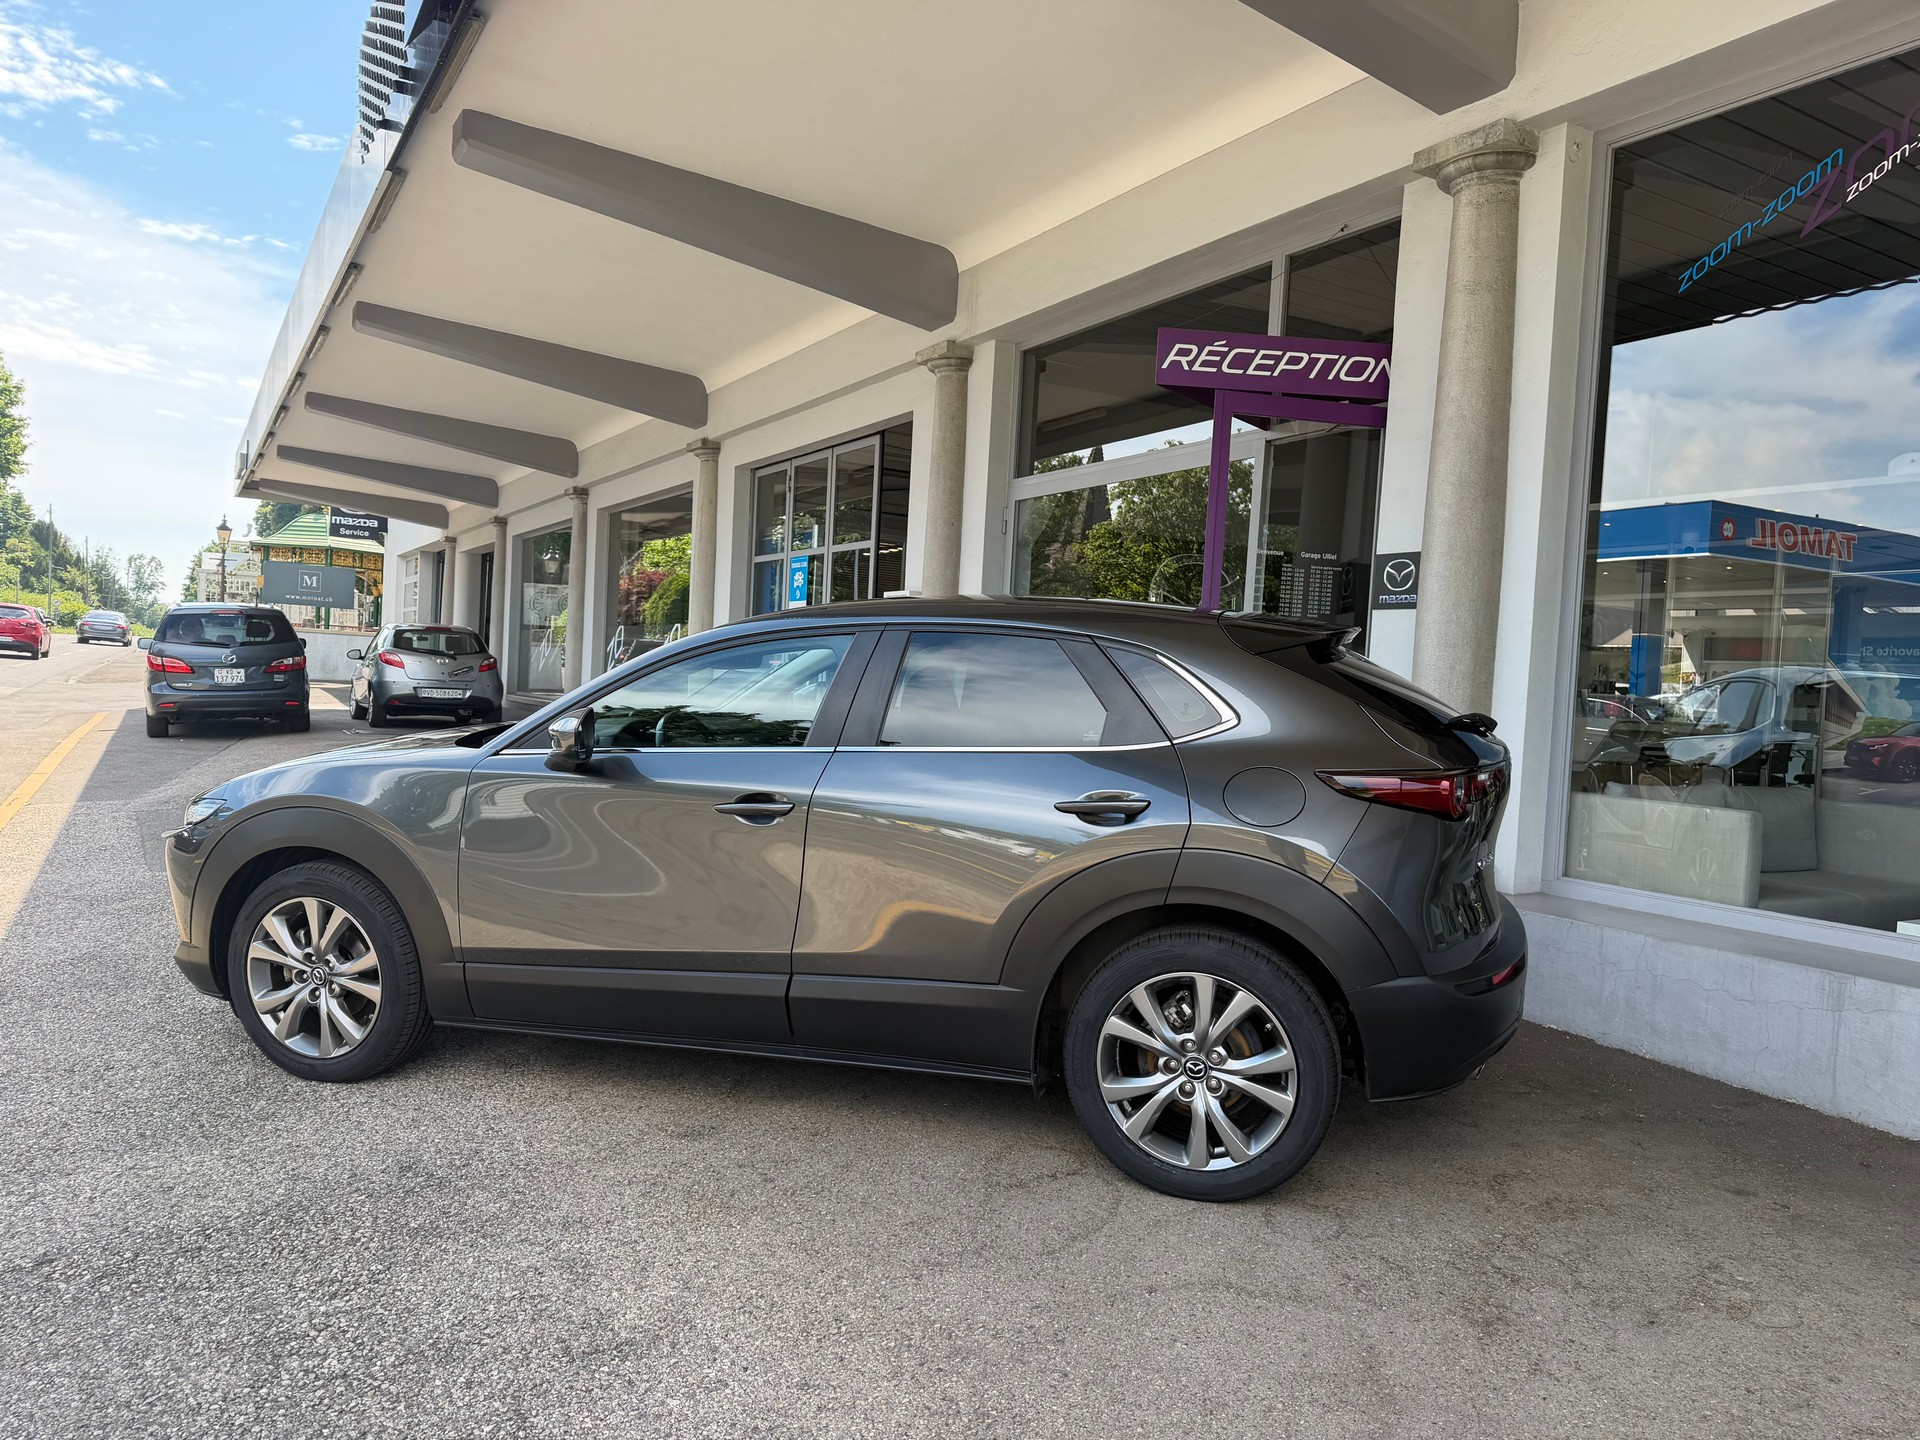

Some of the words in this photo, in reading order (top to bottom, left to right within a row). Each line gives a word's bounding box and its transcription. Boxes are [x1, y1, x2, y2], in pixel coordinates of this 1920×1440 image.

[1678, 147, 1844, 294] zoom-zoom
[331, 515, 378, 528] mazda
[339, 527, 370, 537] Service
[1300, 551, 1321, 560] Garage
[302, 575, 318, 588] M
[285, 594, 333, 603] www.moinat.ch
[1379, 594, 1417, 604] mazda
[215, 675, 229, 683] 137
[230, 675, 244, 683] 974
